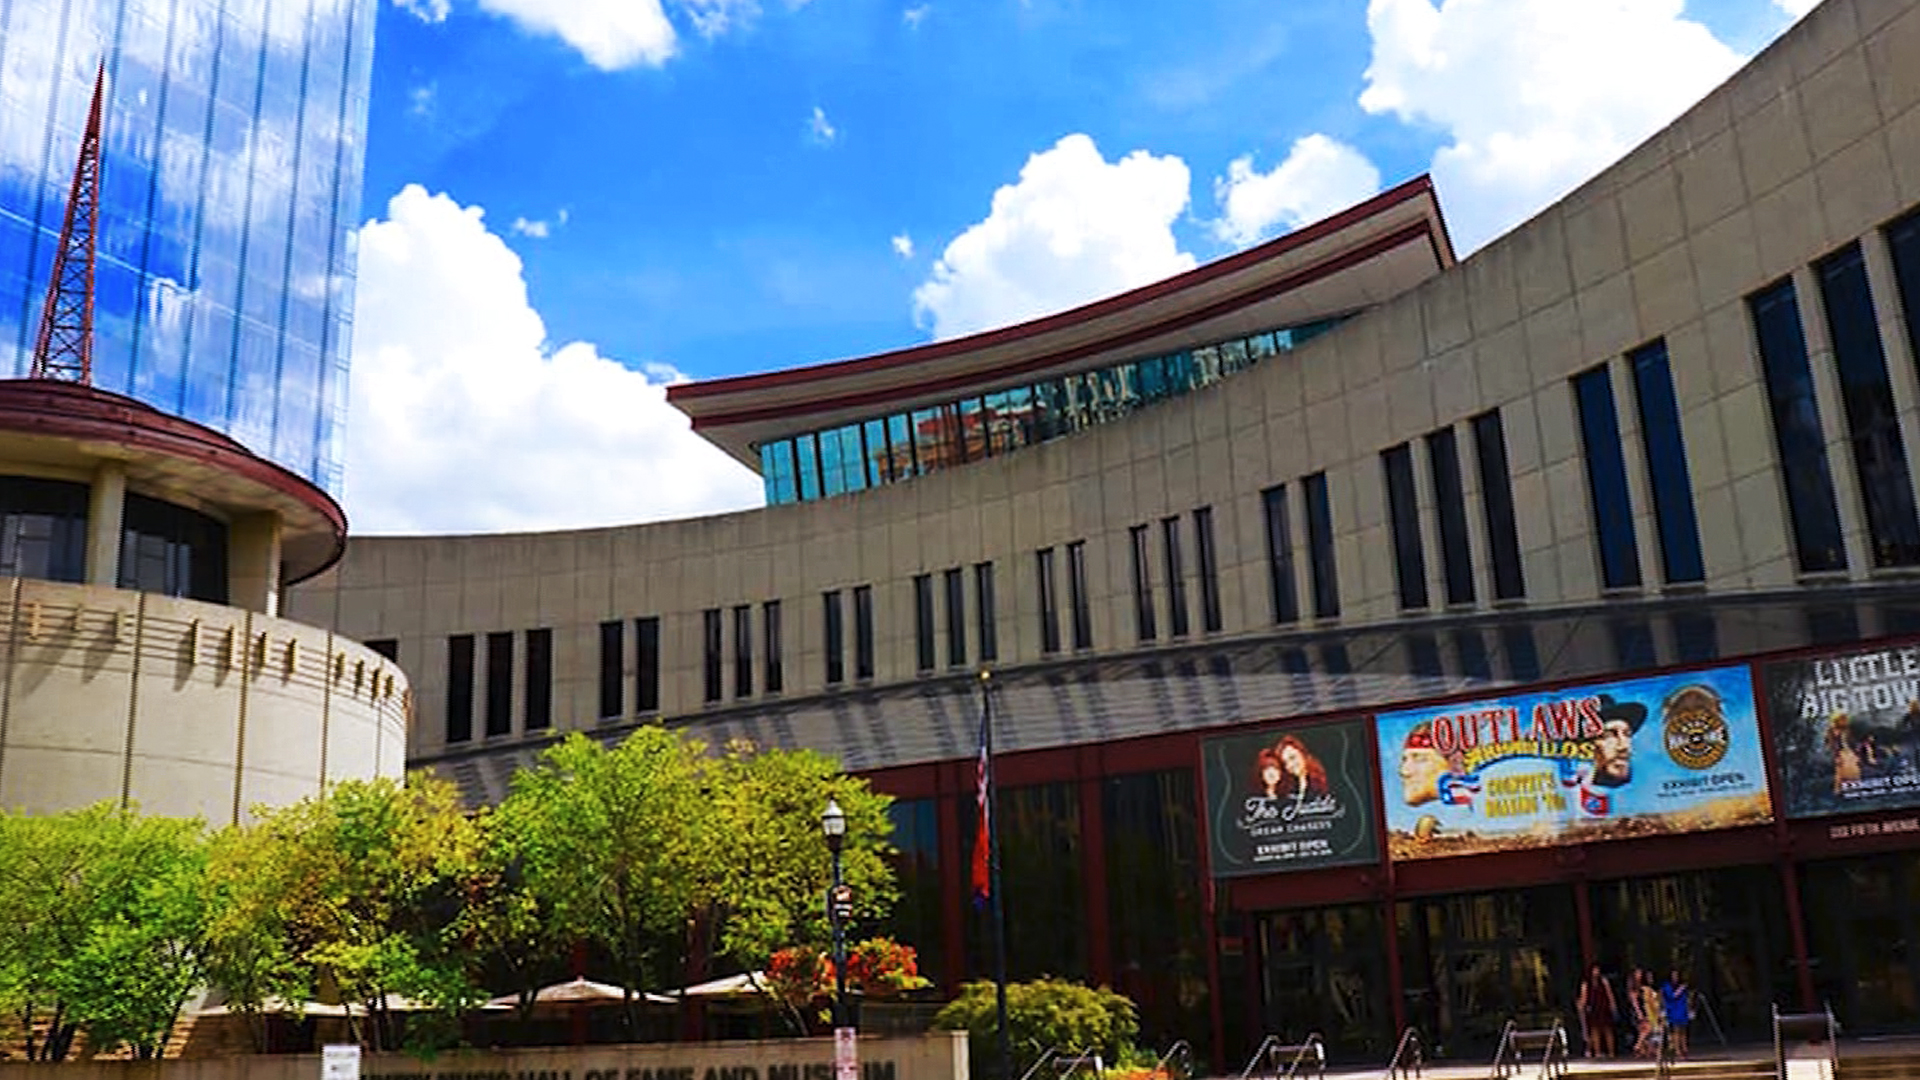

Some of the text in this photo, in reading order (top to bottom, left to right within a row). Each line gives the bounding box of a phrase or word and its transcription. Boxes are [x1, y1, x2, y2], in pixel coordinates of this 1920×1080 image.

[1815, 650, 1920, 686] LITTLE
[1852, 680, 1919, 712] TOW
[1432, 696, 1604, 754] OUTLAWS
[767, 1060, 896, 1080] MUSM
